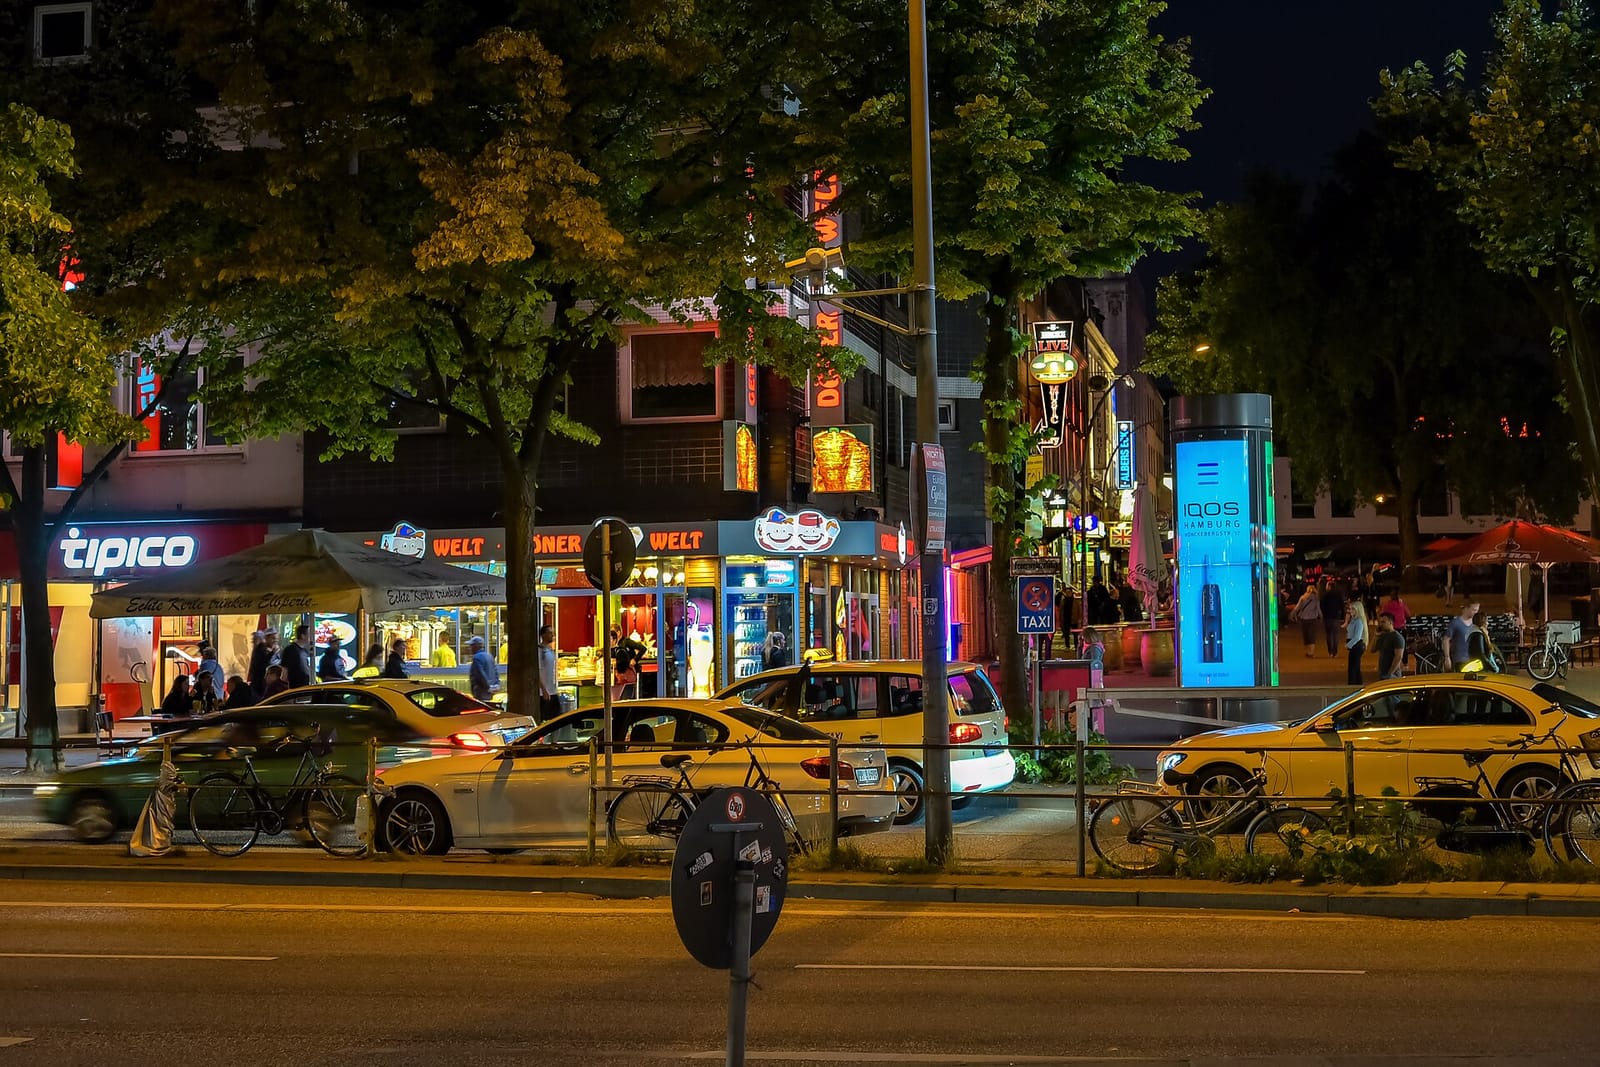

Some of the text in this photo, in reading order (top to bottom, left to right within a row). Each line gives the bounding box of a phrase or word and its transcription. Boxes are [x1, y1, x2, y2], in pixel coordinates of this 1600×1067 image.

[1038, 340, 1069, 351] LIVE
[1120, 449, 1130, 481] ALBERS
[1183, 502, 1240, 518] IQOS
[1183, 520, 1240, 529] HAMBURG
[433, 537, 485, 557] WELT
[533, 530, 704, 554] ÖNER WELT
[60, 527, 195, 576] tipico
[1021, 615, 1051, 628] TAXI
